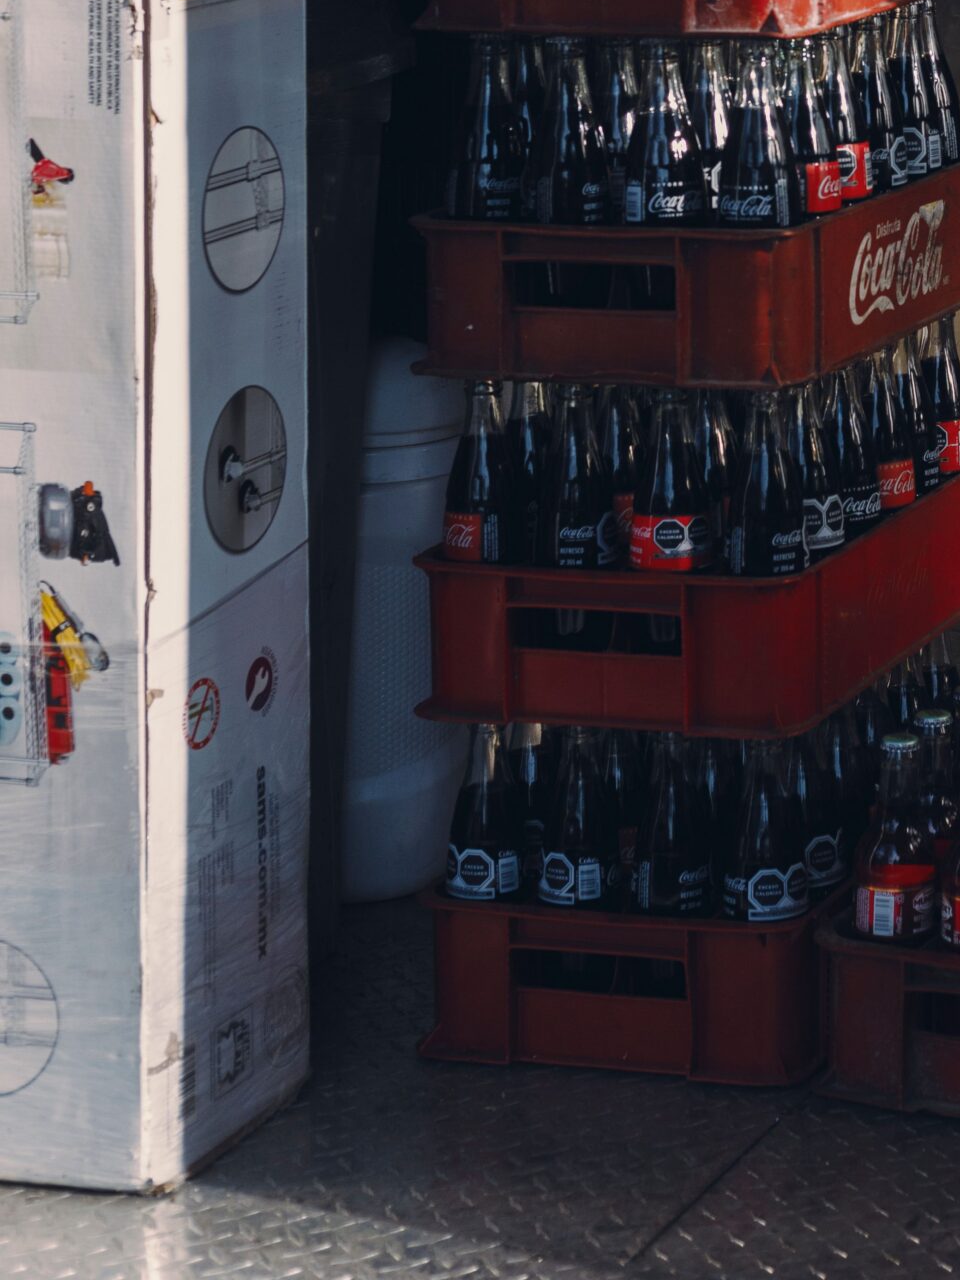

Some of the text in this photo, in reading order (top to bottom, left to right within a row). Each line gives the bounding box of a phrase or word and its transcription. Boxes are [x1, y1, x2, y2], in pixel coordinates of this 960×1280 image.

[719, 194, 774, 216] Coca-Cola
[876, 219, 901, 240] Disfruta
[849, 199, 945, 326] Coca-Cola
[560, 526, 595, 541] Coca-Cola
[256, 766, 268, 961] sams.com.mx
